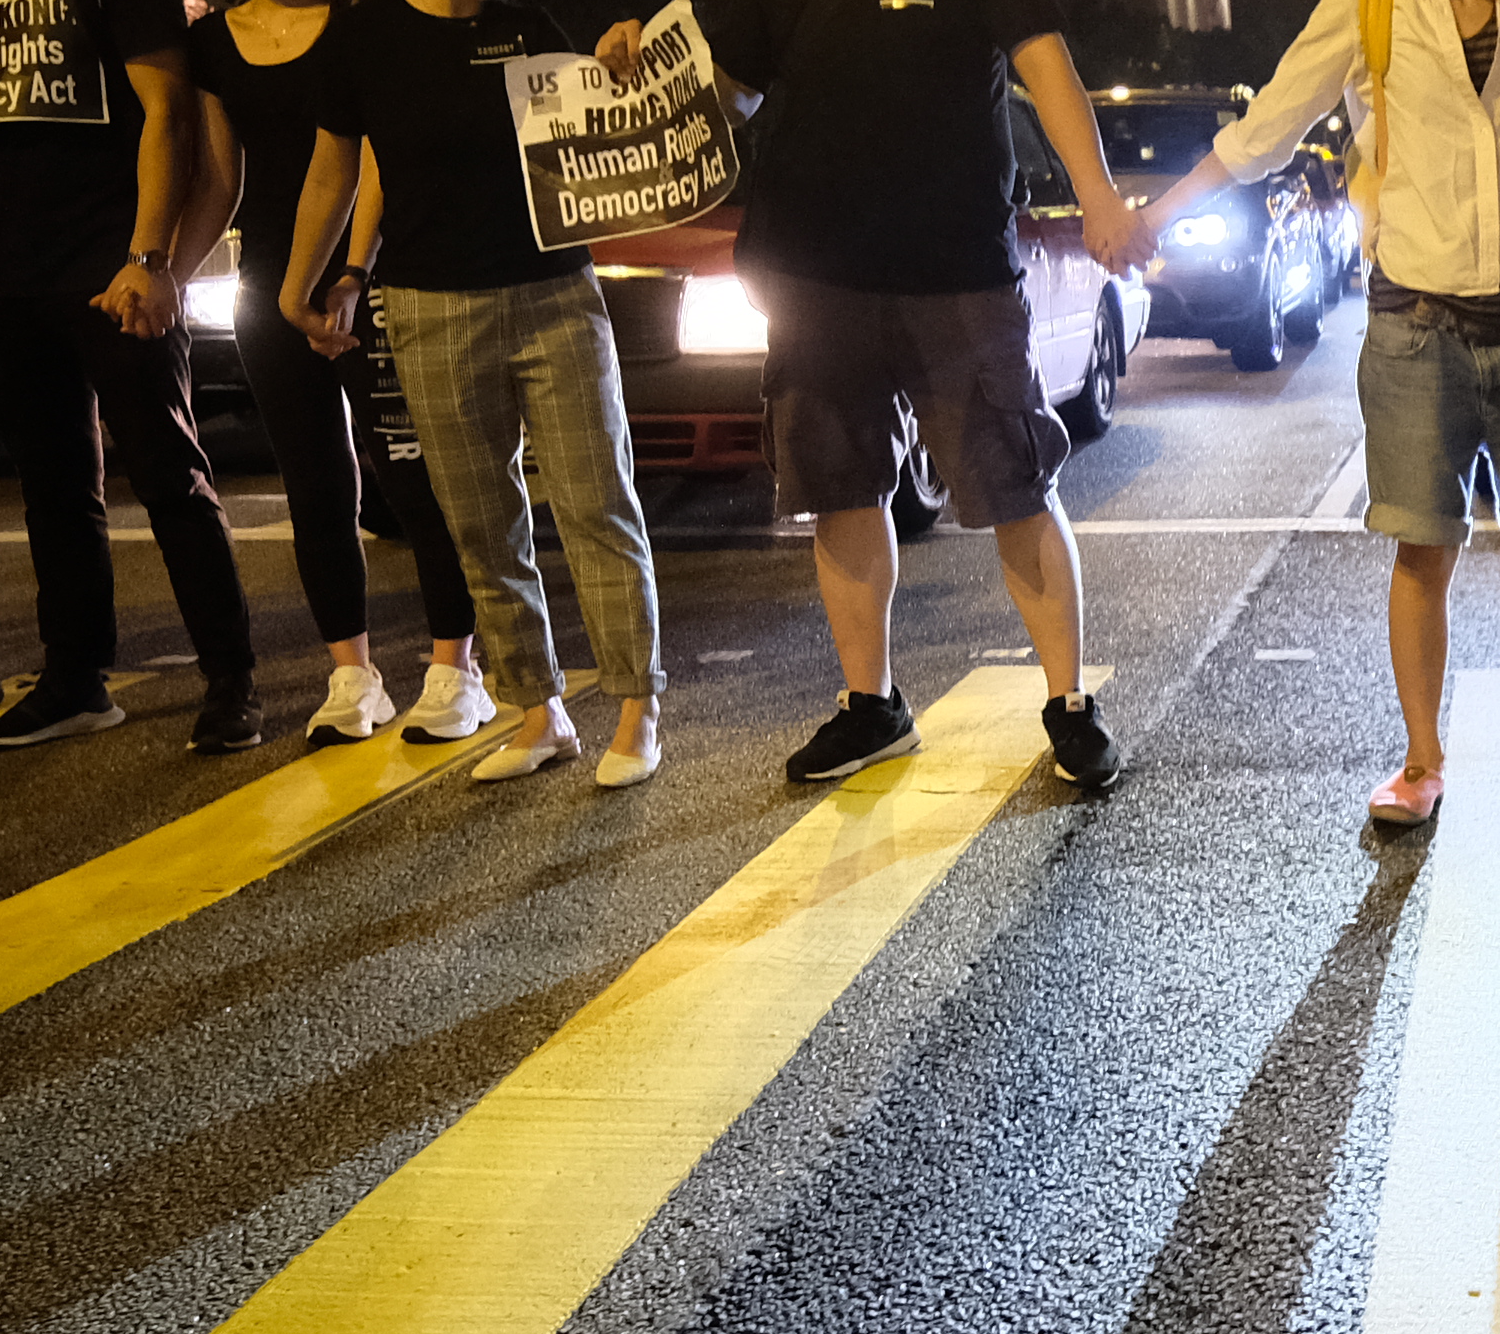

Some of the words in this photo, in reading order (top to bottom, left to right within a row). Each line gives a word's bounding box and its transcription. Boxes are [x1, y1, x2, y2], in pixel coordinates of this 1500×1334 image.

[30, 70, 77, 105] Act
[527, 71, 559, 95] US
[578, 66, 603, 90] TO
[549, 119, 577, 140] the
[584, 92, 668, 136] HONG
[662, 61, 703, 118] KONG
[557, 142, 659, 183] Human
[664, 111, 713, 165] Rights
[558, 169, 700, 228] Democracy
[701, 145, 728, 192] Act
